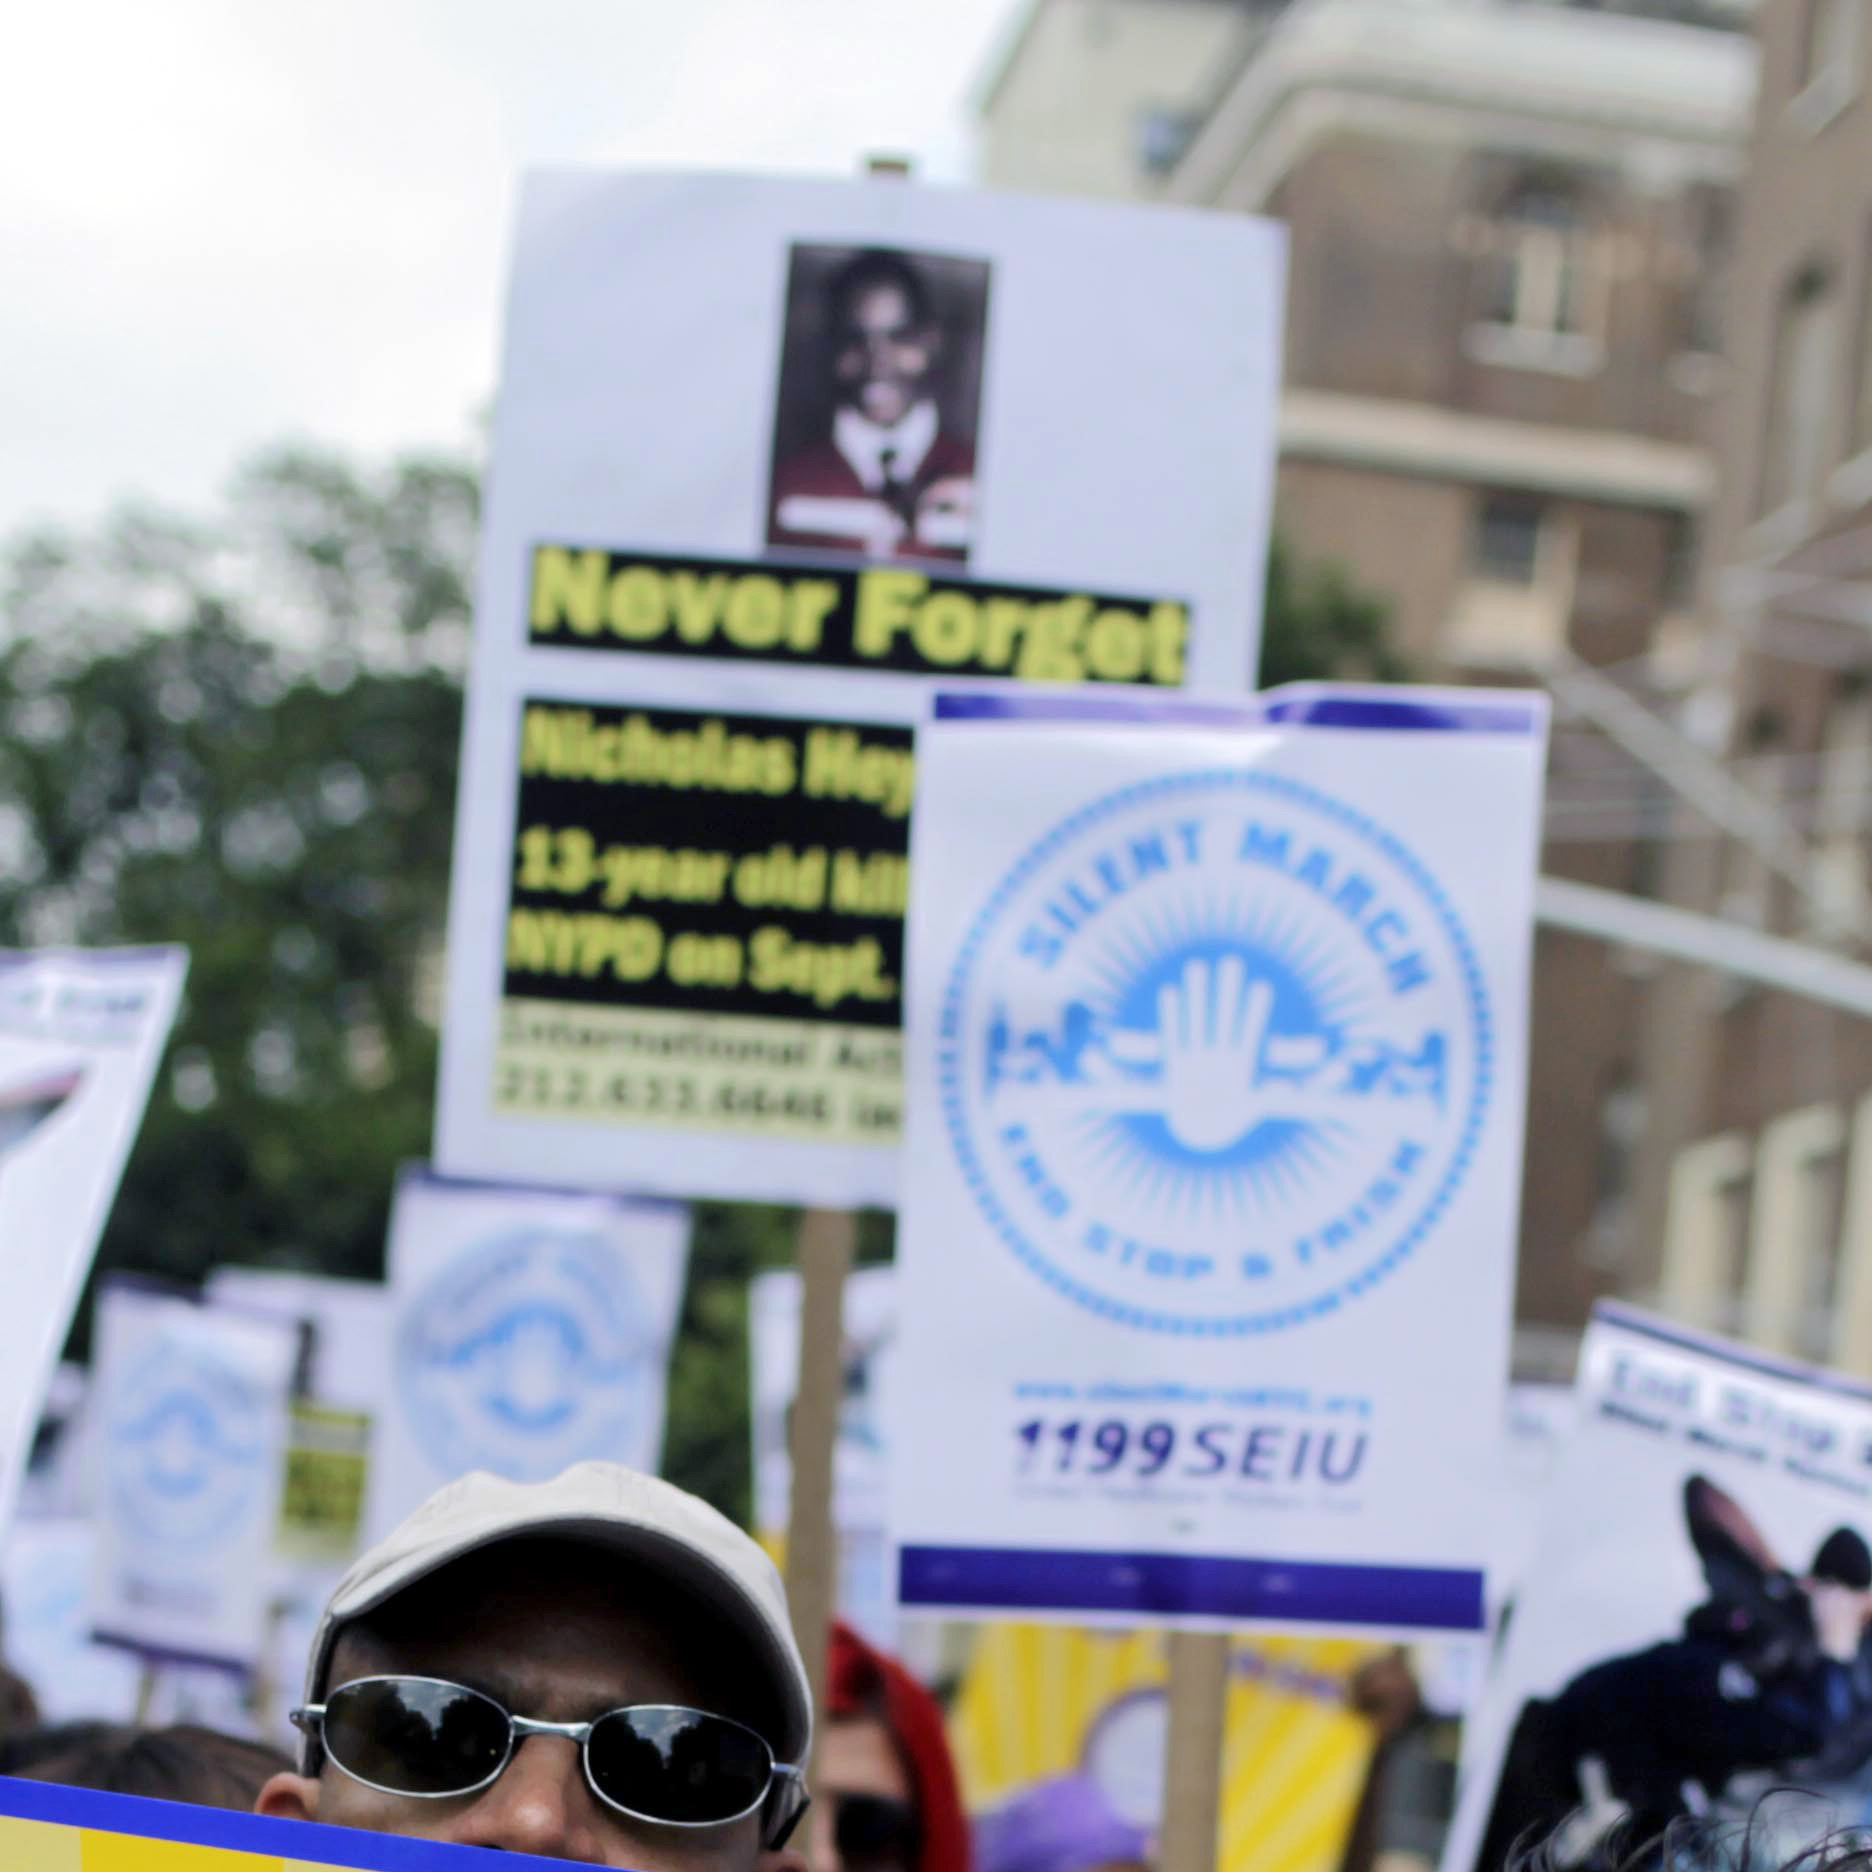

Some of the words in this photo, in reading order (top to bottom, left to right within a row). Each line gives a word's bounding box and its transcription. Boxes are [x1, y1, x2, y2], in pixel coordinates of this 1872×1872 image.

[530, 545, 837, 652] Never
[853, 569, 1189, 684] Forget
[521, 706, 796, 796] Nicholas
[519, 824, 730, 909] 13-year
[734, 844, 827, 909] old
[832, 848, 909, 917] kill
[1018, 820, 1201, 970] SILENT
[1240, 820, 1429, 993] MARCH
[508, 907, 663, 984] NYPD
[667, 933, 744, 987] on
[748, 925, 897, 1009] Sept.
